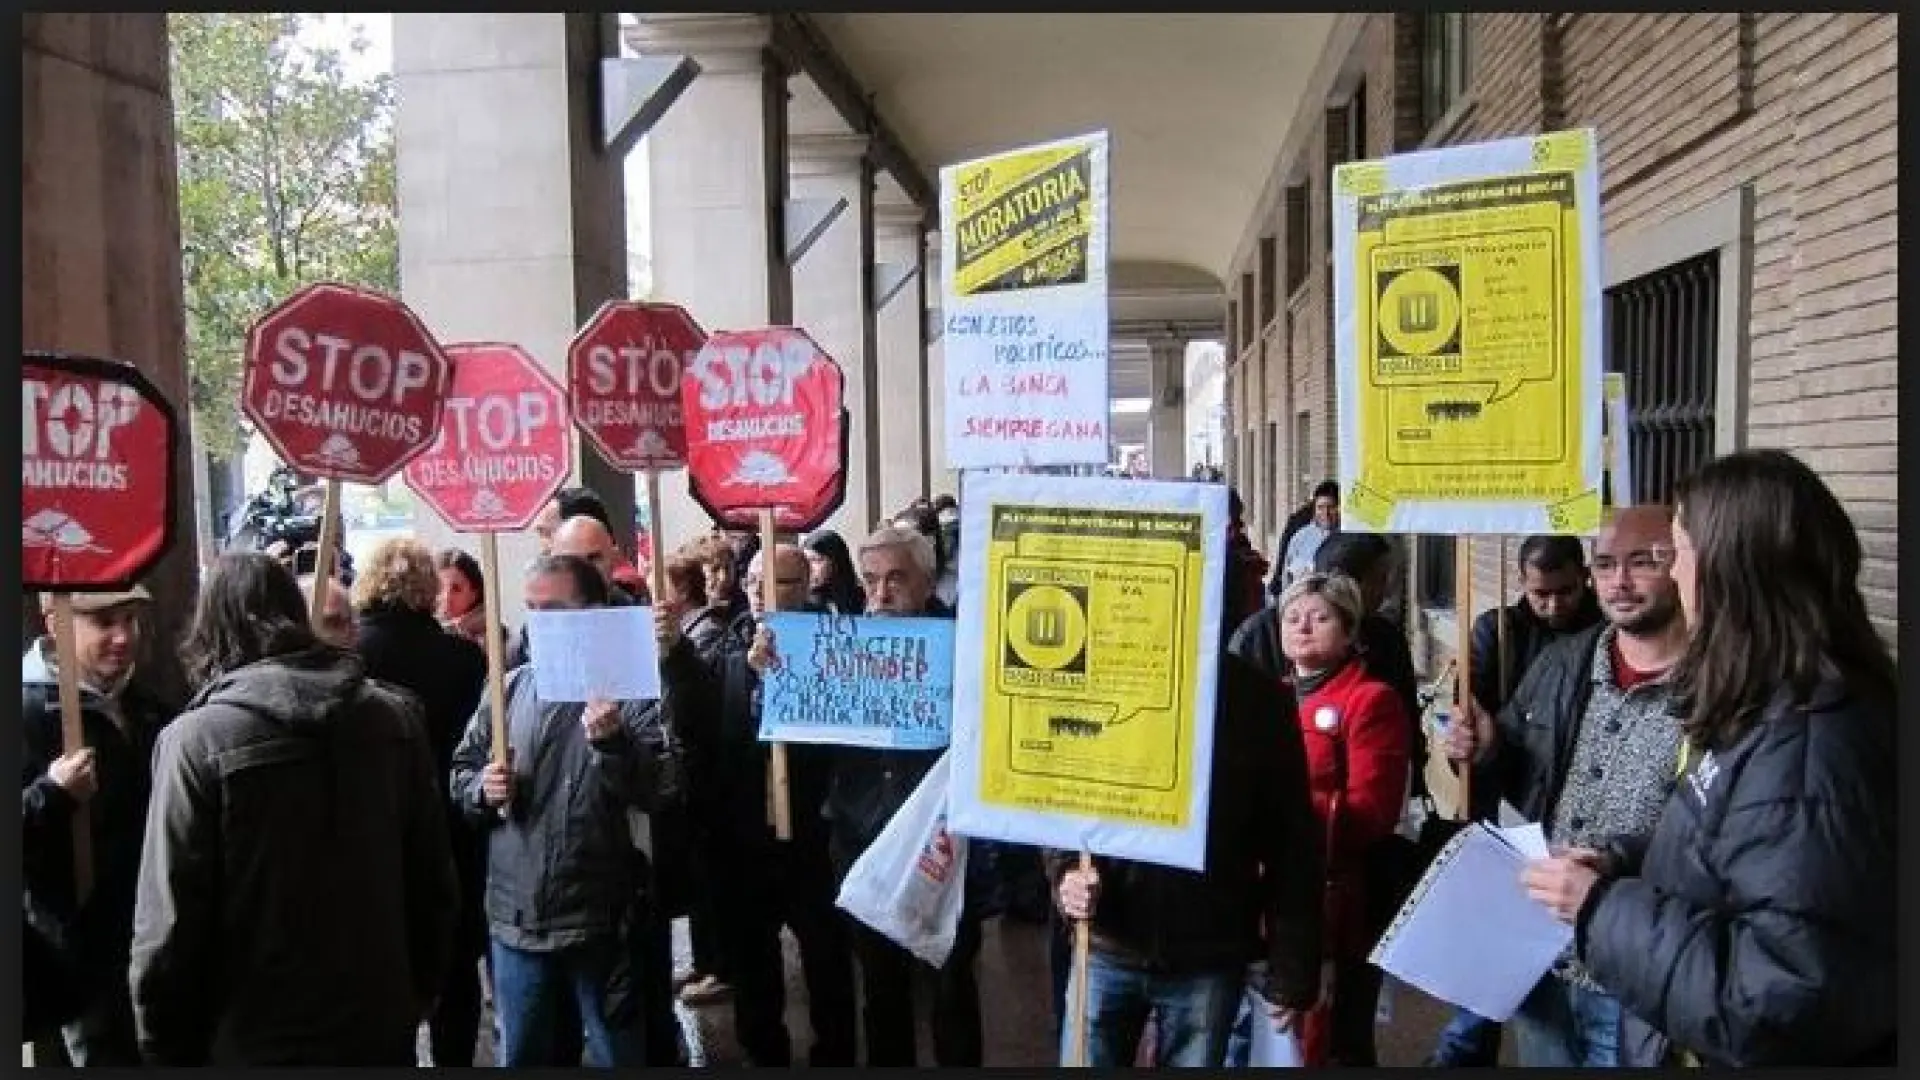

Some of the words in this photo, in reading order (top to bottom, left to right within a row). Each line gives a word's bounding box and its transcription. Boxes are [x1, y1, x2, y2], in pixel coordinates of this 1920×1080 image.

[959, 167, 1087, 253] MORATORIA
[271, 327, 431, 404] STOP
[587, 346, 683, 396] STO
[688, 338, 813, 411] STOP
[22, 380, 141, 458] TOP
[263, 388, 423, 444] DESAHUCIOS
[438, 391, 549, 452] TOP
[587, 400, 684, 426] DESAHUC
[22, 460, 128, 491] AHUCIOS
[421, 454, 555, 486] DESAHUCIOS
